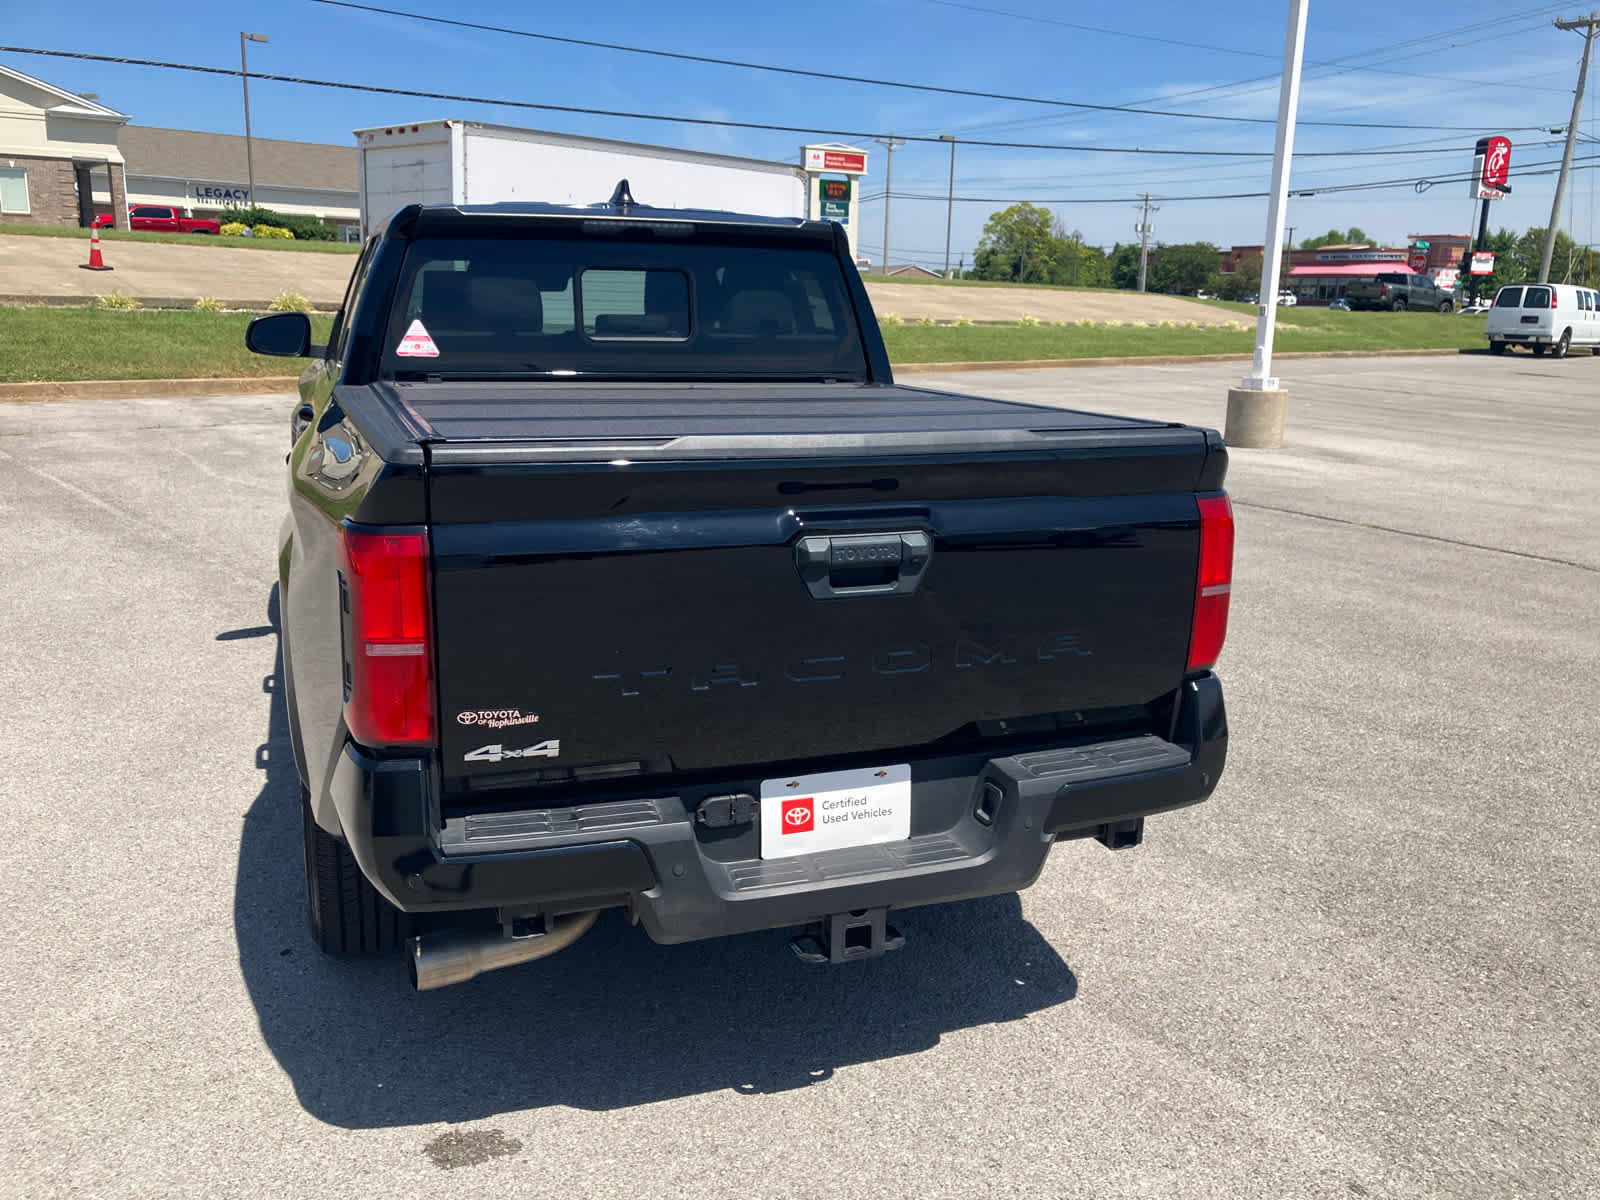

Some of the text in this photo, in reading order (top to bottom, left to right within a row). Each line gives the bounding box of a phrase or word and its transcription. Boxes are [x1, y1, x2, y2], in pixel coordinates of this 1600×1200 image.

[195, 186, 249, 200] LEGACY
[835, 546, 899, 560] TOYOTA
[478, 710, 521, 719] TOYOTA
[488, 714, 540, 728] Hopkinsville
[822, 795, 868, 811] Certified
[822, 807, 893, 824] Used Vehicles
